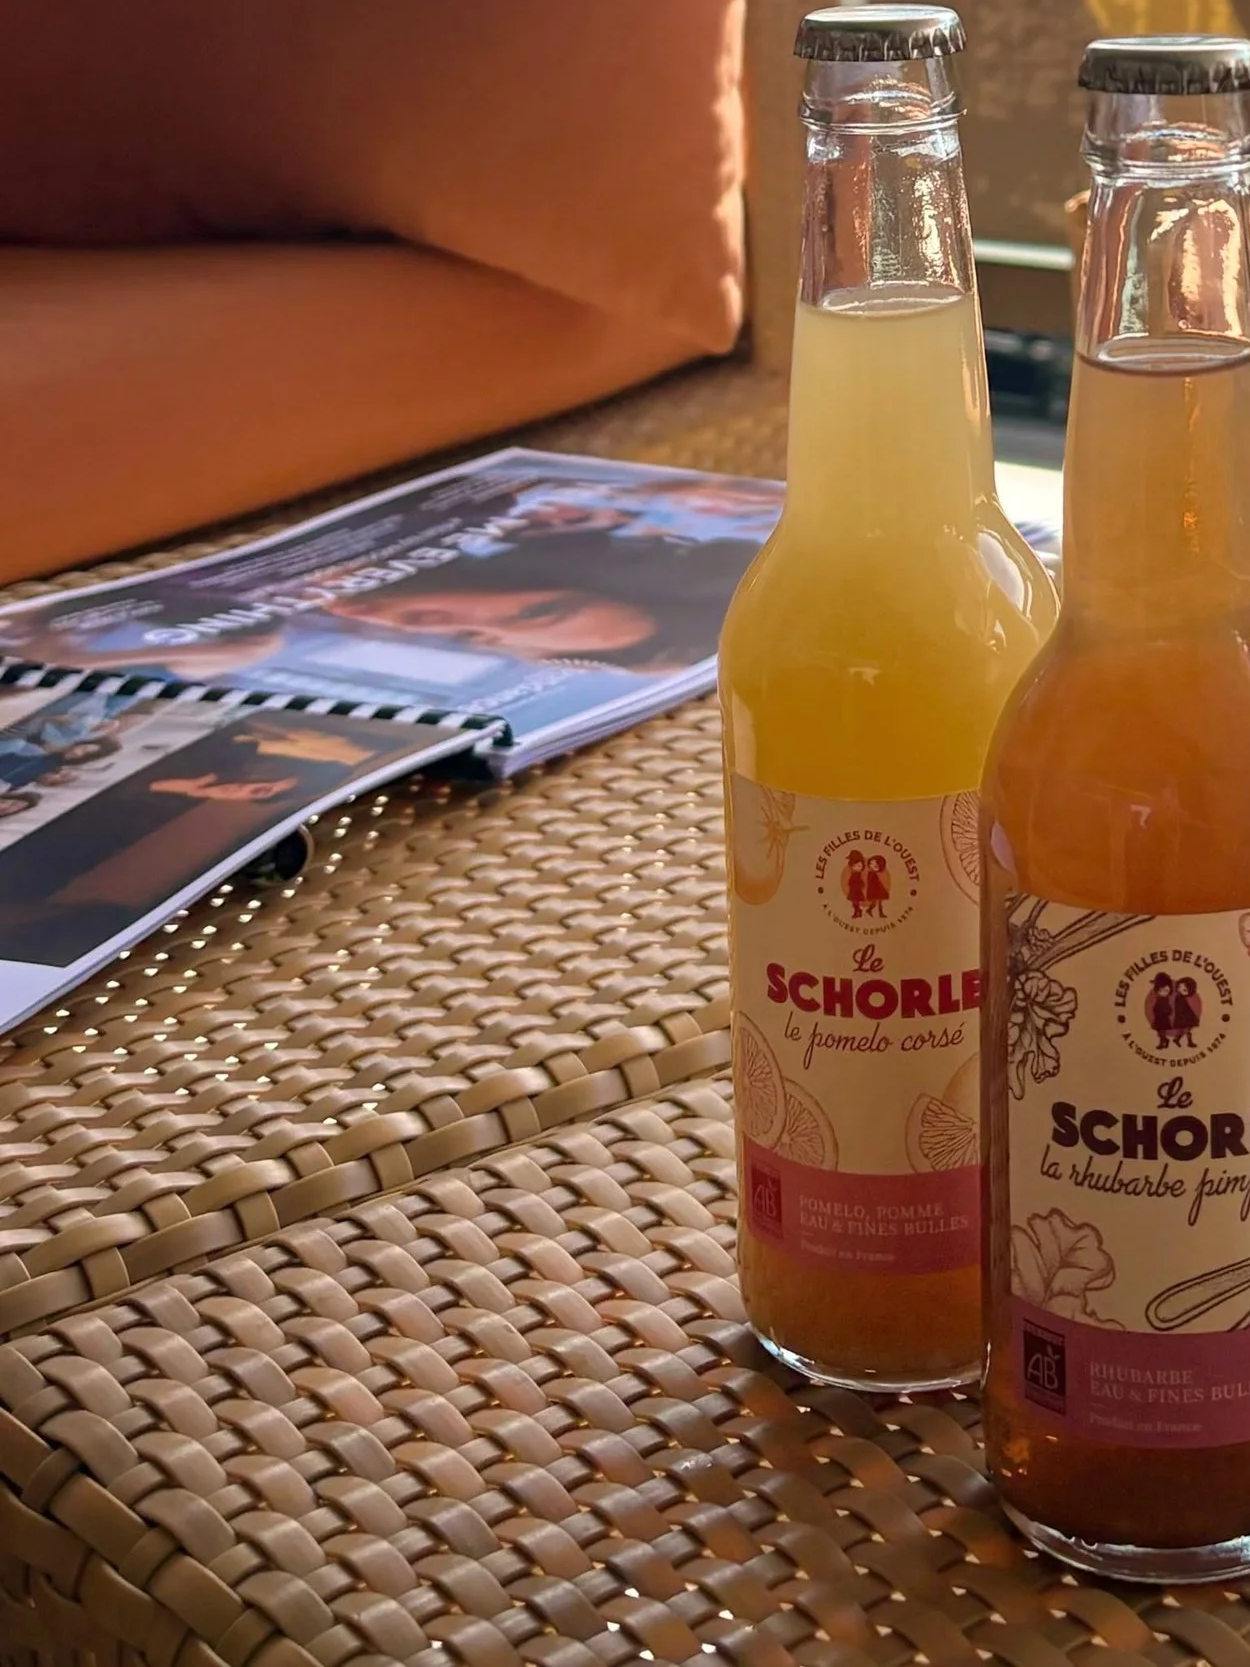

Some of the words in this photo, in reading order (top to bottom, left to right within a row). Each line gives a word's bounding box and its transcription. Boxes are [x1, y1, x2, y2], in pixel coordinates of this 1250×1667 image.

[144, 546, 460, 646] EVERYTHING
[815, 855, 828, 880] LES
[823, 830, 861, 857] FILLES
[864, 830, 882, 842] DE
[884, 835, 920, 882] L'OUEST
[853, 944, 885, 973] Le
[767, 962, 982, 1020] SCHORLE
[1114, 979, 1130, 1007] LES
[1124, 951, 1168, 982] FILLES
[1172, 950, 1193, 963] DE
[1194, 955, 1233, 1006] L'OUEST
[784, 1011, 802, 1041] le
[803, 1022, 894, 1070] pomelo
[901, 1022, 967, 1052] corsé
[1170, 1051, 1207, 1068] DEPUIS
[1156, 1076, 1193, 1109] Le
[1040, 1143, 1062, 1181] la
[1068, 1155, 1187, 1198] rhubarbe
[800, 1194, 871, 1222] POMELO,
[877, 1202, 945, 1220] POMME
[800, 1212, 828, 1230] EAU
[848, 1221, 897, 1237] FINES
[904, 1215, 969, 1236] BULLES
[1026, 1352, 1059, 1390] AB
[1089, 1360, 1194, 1386] RHUBARBE
[1089, 1382, 1125, 1401] EAU
[1129, 1390, 1143, 1403] &
[1147, 1387, 1204, 1404] FINES
